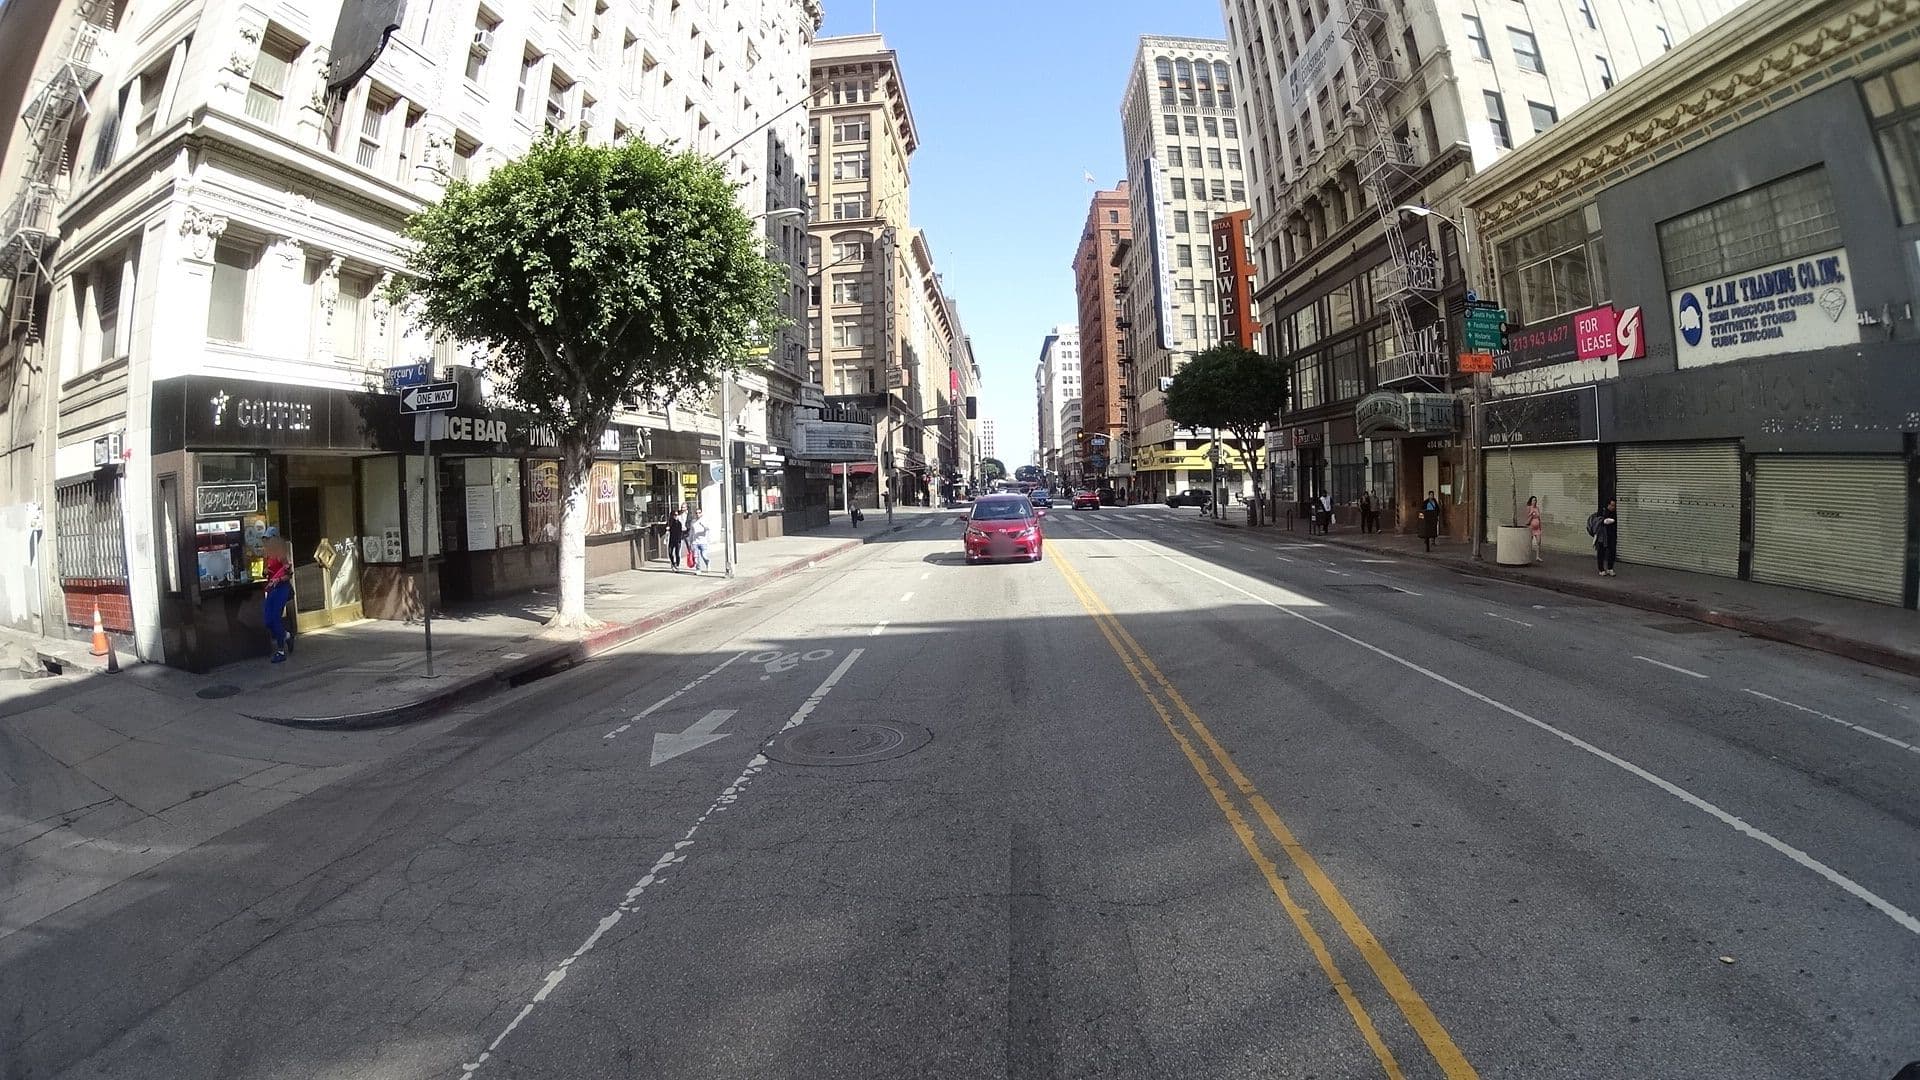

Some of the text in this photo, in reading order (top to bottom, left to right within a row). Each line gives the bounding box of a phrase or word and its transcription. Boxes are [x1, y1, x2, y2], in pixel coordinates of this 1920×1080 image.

[1217, 234, 1236, 346] JEWEL
[1739, 267, 1797, 302] TRADING
[885, 251, 896, 365] VINCENT
[1730, 299, 1776, 319] PRECIOUS
[1777, 291, 1815, 310] STONES
[1579, 316, 1598, 335] FOR
[1709, 309, 1797, 336] SYNTHETIC STONES
[1512, 336, 1529, 350] 213
[1581, 332, 1613, 353] LEASE
[1711, 326, 1784, 349] CUBIC ZIRCONIA
[385, 364, 427, 381] Mercury Ct
[416, 390, 451, 404] ONE WAY
[238, 398, 311, 430] COFFEE
[474, 418, 508, 442] BAR
